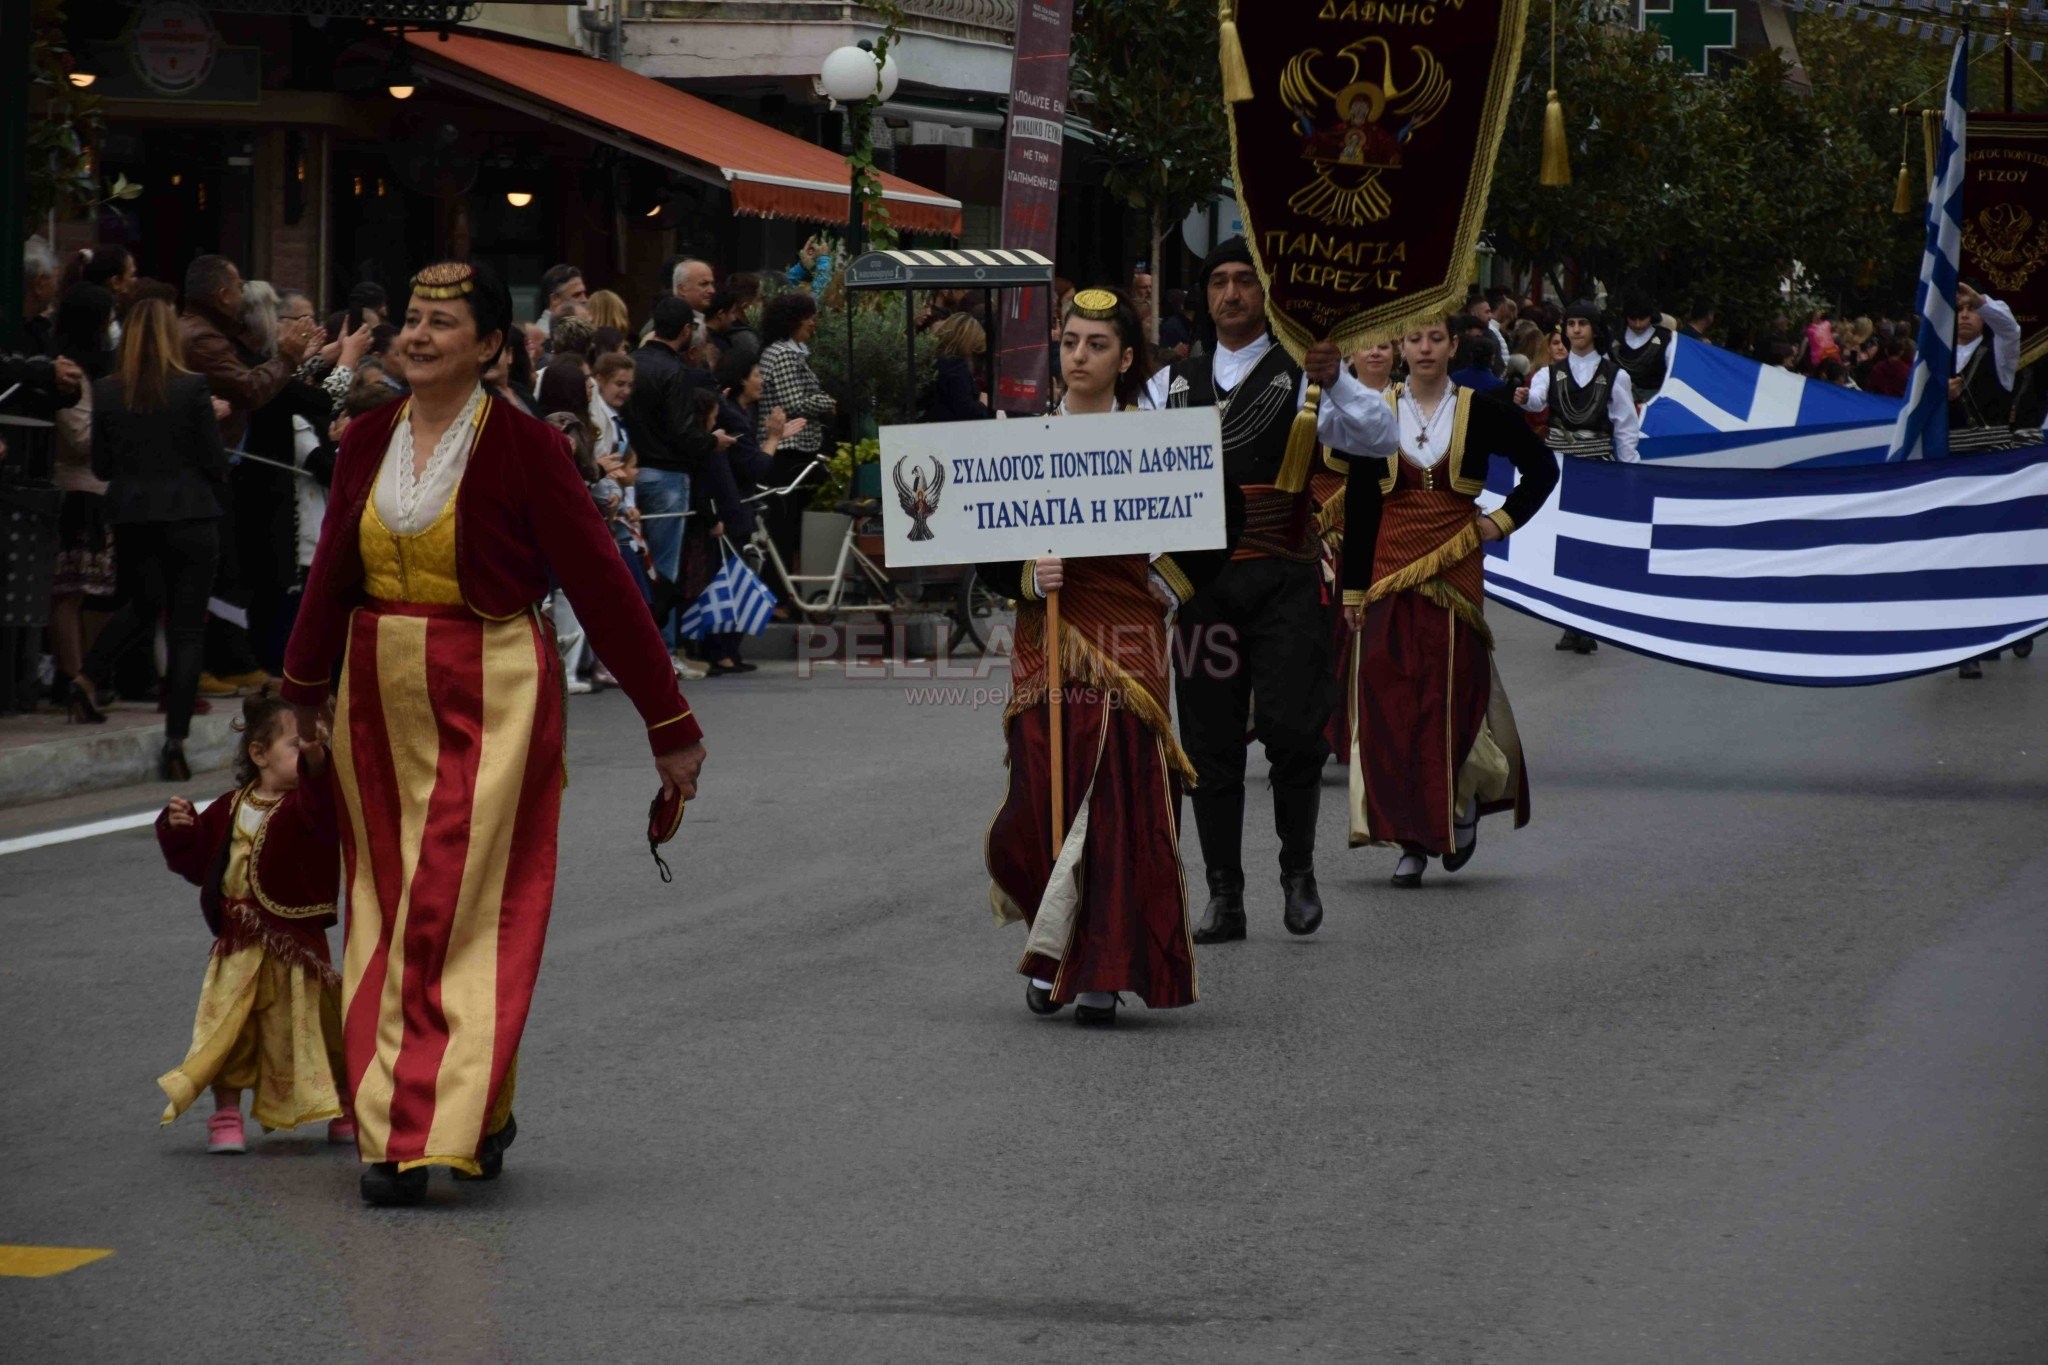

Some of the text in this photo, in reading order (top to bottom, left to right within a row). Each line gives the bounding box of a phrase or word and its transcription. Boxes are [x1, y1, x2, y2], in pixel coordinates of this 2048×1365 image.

[1022, 149, 1049, 163] ΜΕ ΤΗΝ
[1978, 169, 2028, 184] ΡΙΖΟΥ
[1264, 230, 1406, 266] ΠΑΝΑΓΙΑ
[1289, 262, 1402, 292] ΚΙΡΕΖΛΙ
[952, 444, 1214, 485] ΣΥΛΛΟΓΟΣ ΠΟΝΤΙΩΝ ΔΑΦΝΗΣ
[1091, 501, 1107, 523] Η
